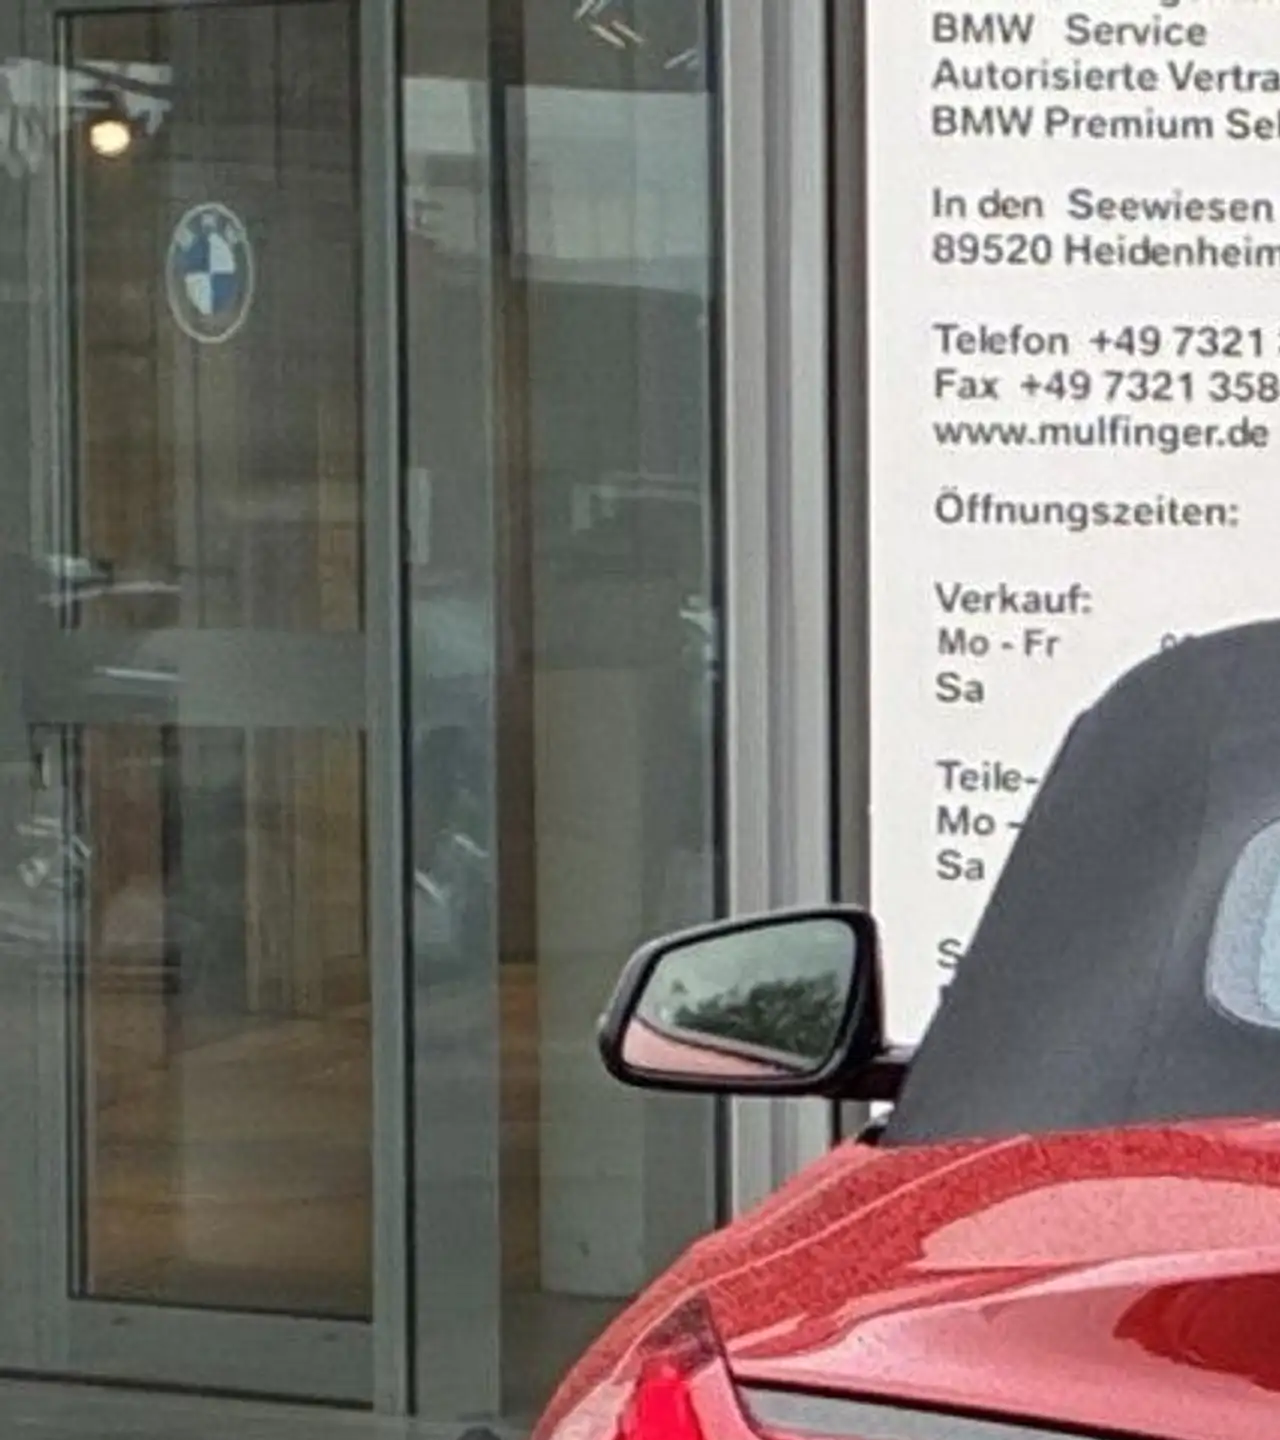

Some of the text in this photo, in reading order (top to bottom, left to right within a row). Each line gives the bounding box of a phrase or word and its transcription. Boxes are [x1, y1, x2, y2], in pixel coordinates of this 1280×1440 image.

[932, 12, 1208, 47] BMW Service
[932, 58, 1158, 93] Autorisierte
[932, 104, 1034, 138] BMW
[1044, 105, 1214, 140] Premium
[932, 187, 967, 218] In
[977, 189, 1044, 220] den
[1067, 188, 1274, 223] Seewiesen
[932, 232, 1053, 266] 89520
[932, 322, 1070, 356] Telefon
[1090, 325, 1162, 357] +49
[1173, 325, 1264, 358] 7321
[934, 367, 999, 400] Fax
[1020, 369, 1092, 401] +49
[1104, 369, 1194, 402] 7321
[933, 415, 1270, 451] www.mulfinger.de
[934, 486, 1239, 533] Öffnungszeiten:
[934, 582, 1093, 616] Verkauf:
[937, 627, 990, 657] Mo
[1022, 628, 1061, 657] Fr
[935, 671, 985, 704] Sa
[936, 805, 996, 837] Mo
[936, 848, 985, 882] Sa
